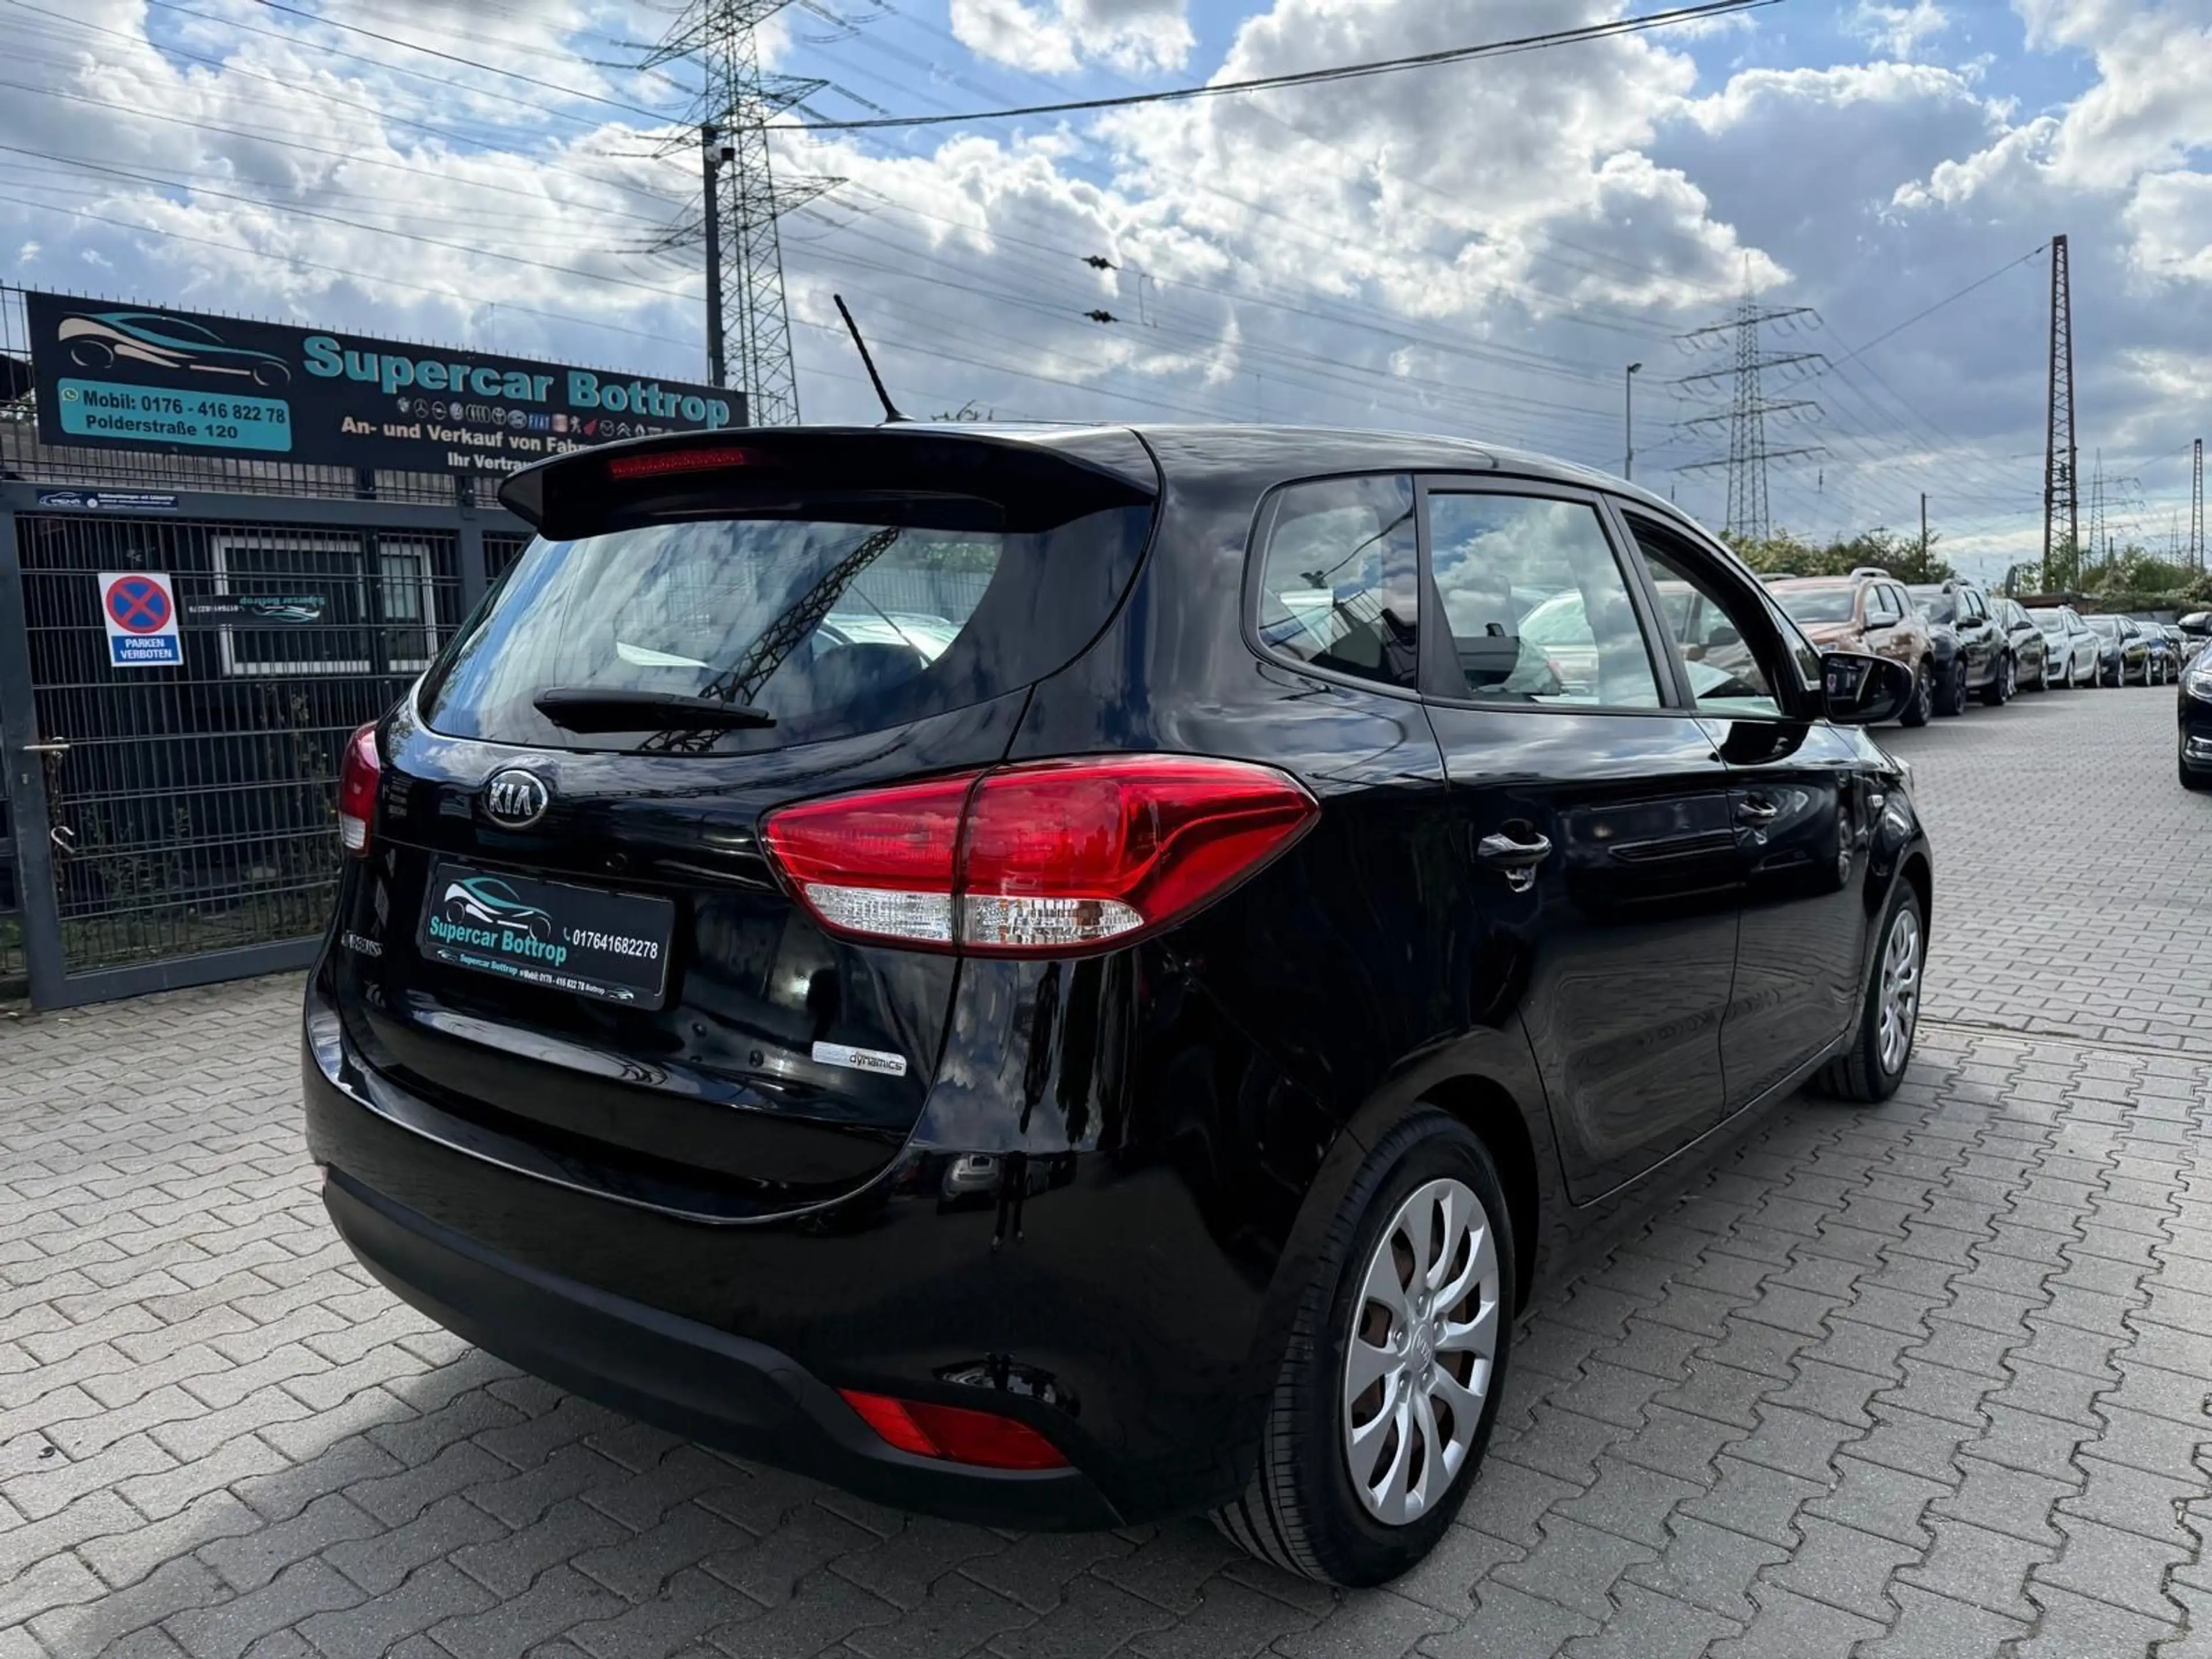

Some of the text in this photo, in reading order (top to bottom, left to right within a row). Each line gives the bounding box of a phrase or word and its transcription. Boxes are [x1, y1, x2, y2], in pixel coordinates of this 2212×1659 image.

[304, 336, 730, 431] Supercar Bottrop
[83, 390, 136, 410] Mobil:
[141, 396, 183, 414] 0176
[198, 402, 228, 419] 416
[232, 404, 262, 421] 822
[266, 407, 286, 423] 78
[86, 414, 238, 439] Polderstraße 120
[342, 416, 377, 434] An-
[384, 423, 421, 439] und
[427, 425, 503, 448] Verkauf
[509, 436, 541, 452] von
[447, 451, 471, 467] Ihr
[120, 649, 172, 660] VERBOTEN
[124, 638, 165, 648] PARKEN
[489, 783, 532, 815] KIA
[430, 916, 567, 967] Supercar Bottrop
[573, 929, 658, 959] 017641682278
[460, 953, 490, 968] Supercar
[491, 960, 518, 977] Bottrop
[849, 1051, 904, 1071] dynamics
